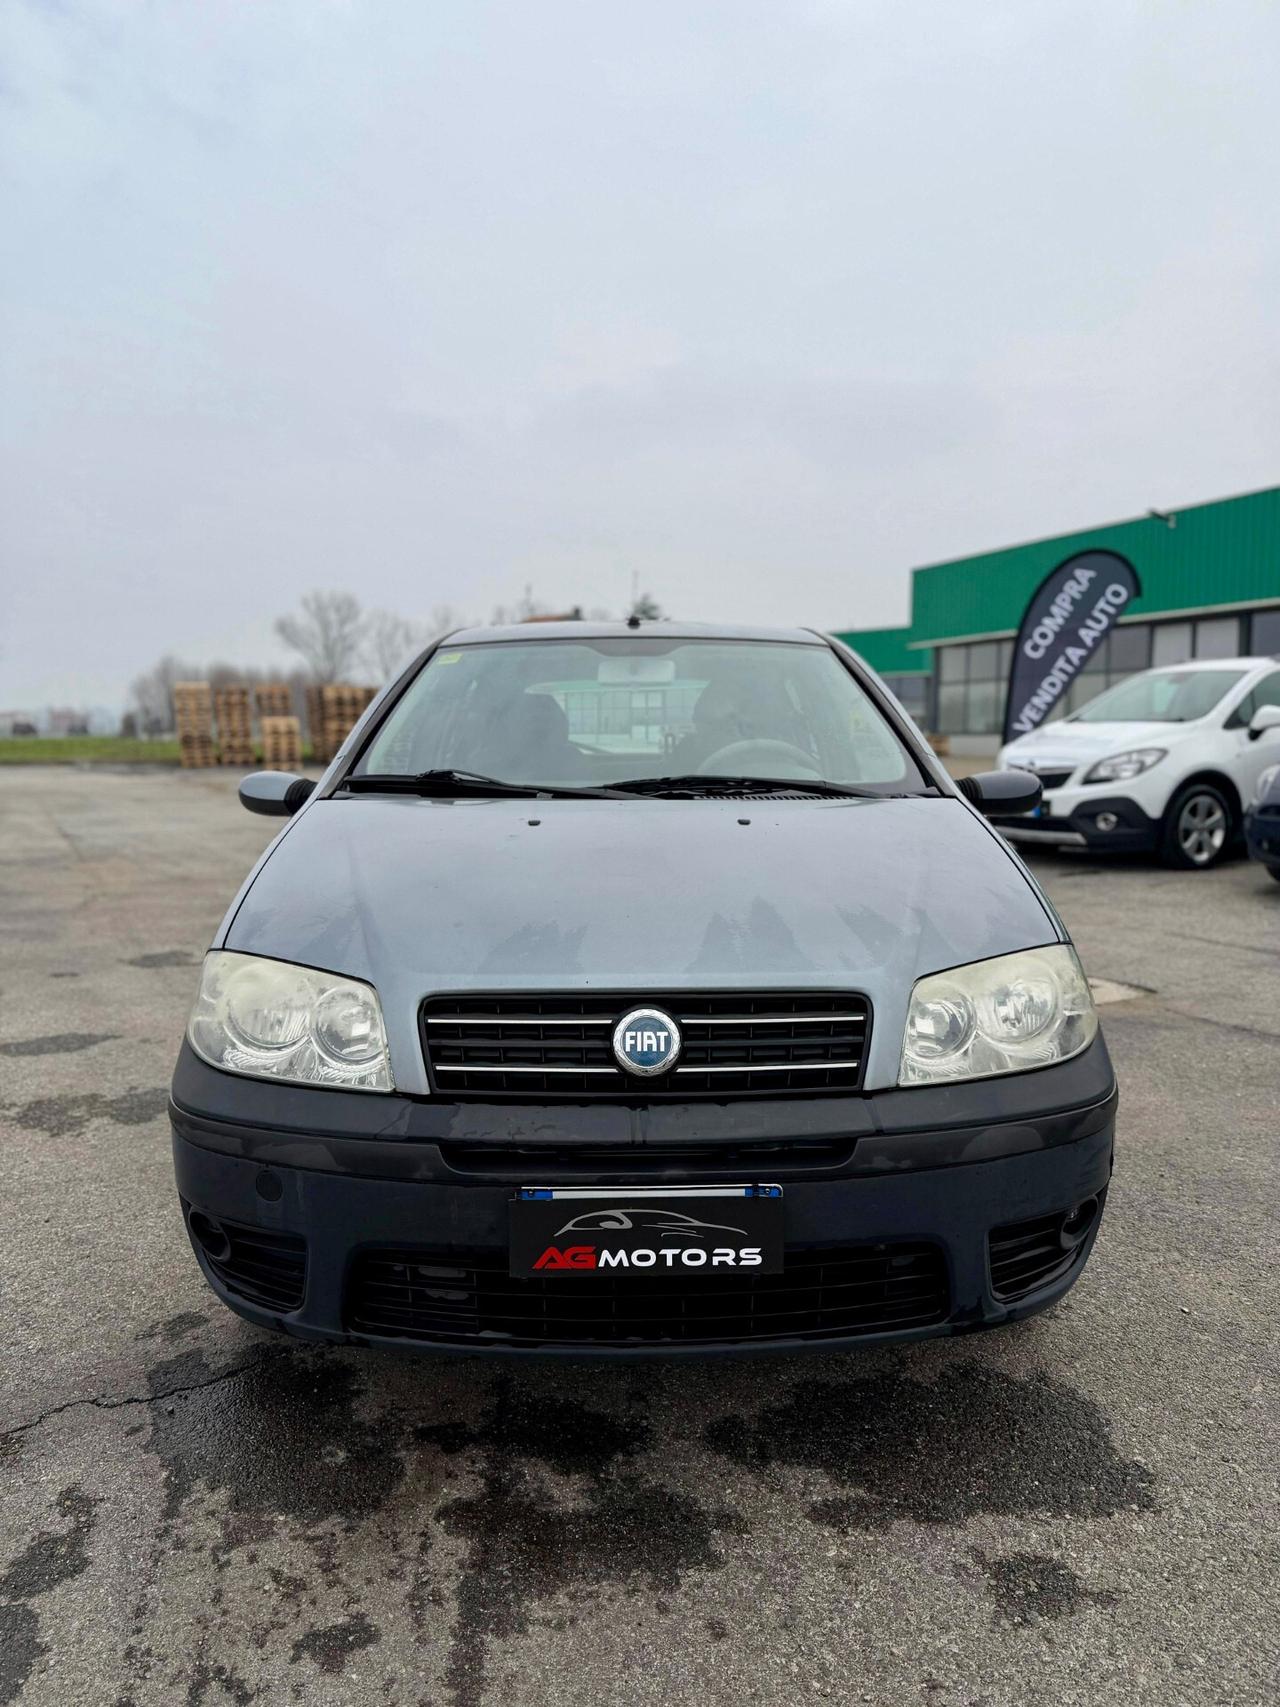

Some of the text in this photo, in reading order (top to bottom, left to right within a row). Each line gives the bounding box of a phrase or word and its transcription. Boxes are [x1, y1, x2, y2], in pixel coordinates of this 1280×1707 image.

[1013, 583, 1129, 733] VENDITA AUTO
[1024, 567, 1097, 660] COMPRA
[625, 1031, 668, 1052] FIAT
